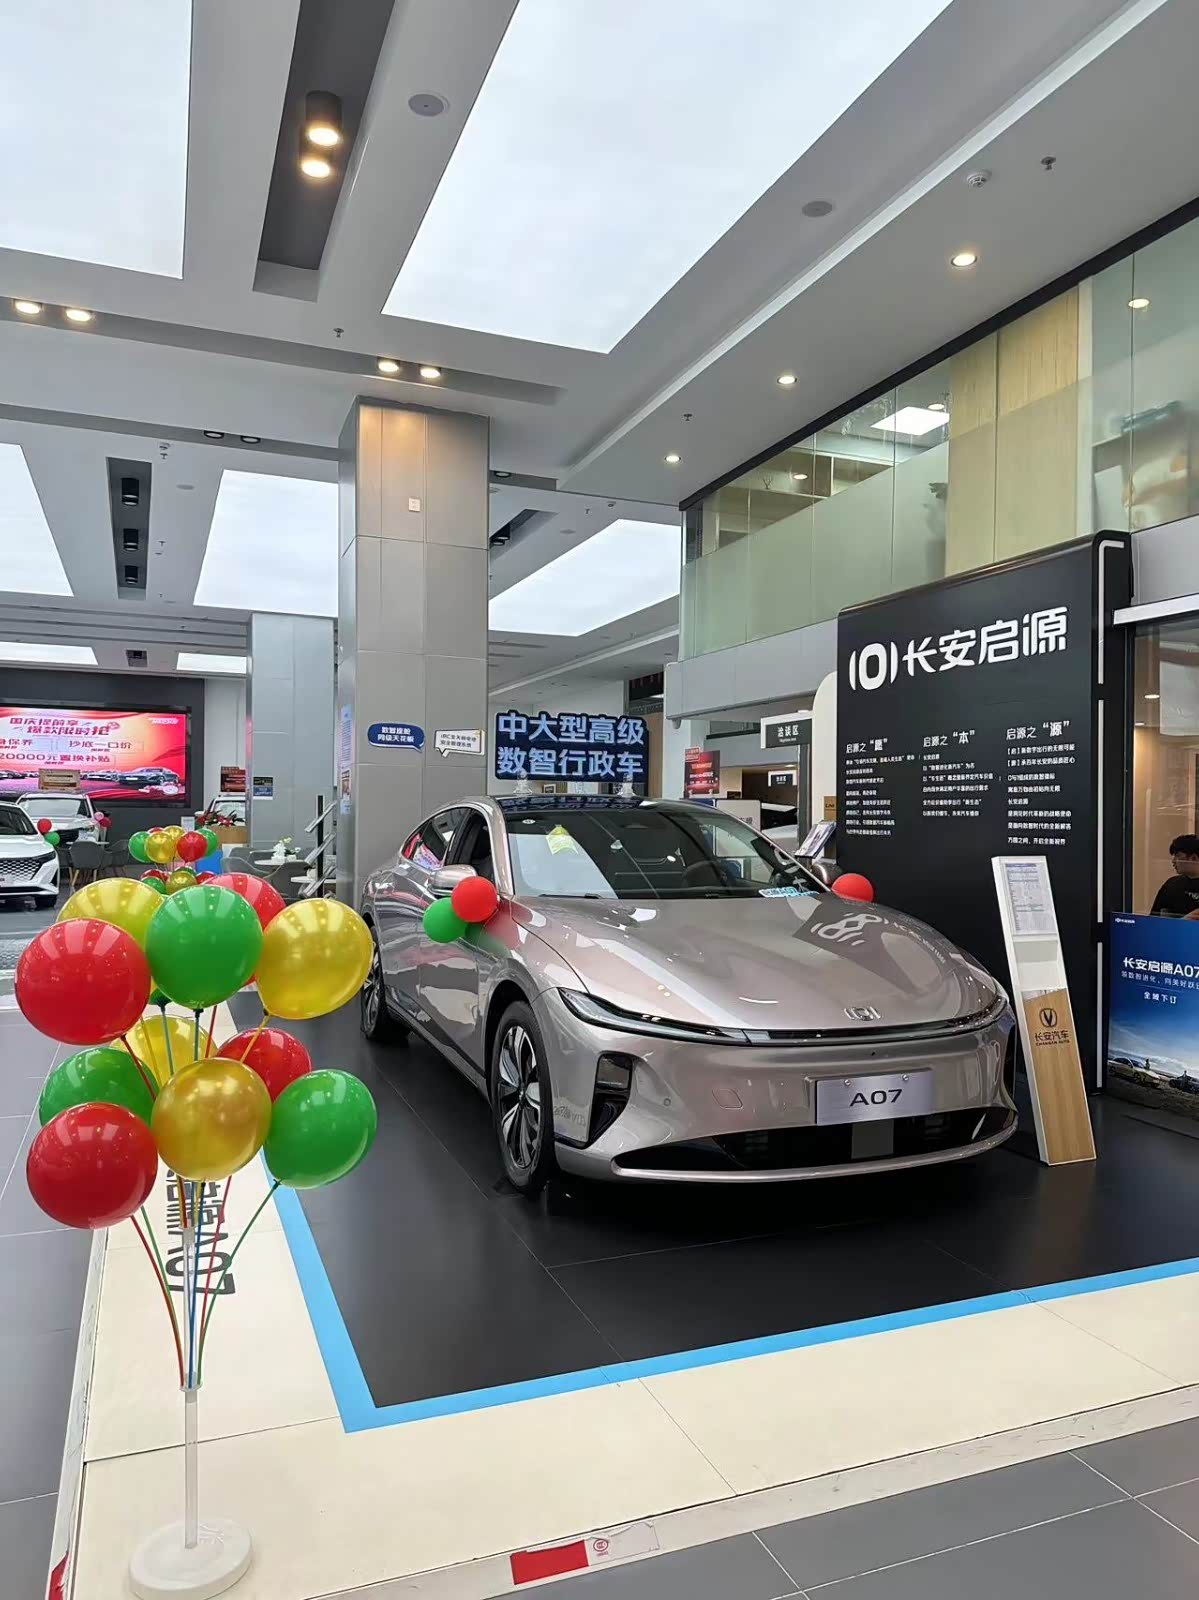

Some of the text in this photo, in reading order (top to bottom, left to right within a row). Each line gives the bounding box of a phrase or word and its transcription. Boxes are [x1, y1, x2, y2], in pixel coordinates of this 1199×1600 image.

[903, 606, 1069, 677] 长安启源
[26, 726, 111, 736] 爆款限时抢
[497, 711, 645, 746] 中大型高级
[777, 724, 799, 738] 洽谈区
[69, 740, 132, 749] 抄底一口价
[496, 747, 645, 779] 数智行政车
[1122, 956, 1199, 979] 长安启源A07
[1143, 991, 1177, 1005] 全域下订
[1035, 1029, 1069, 1042] 长安汽车
[849, 1087, 904, 1107] A07
